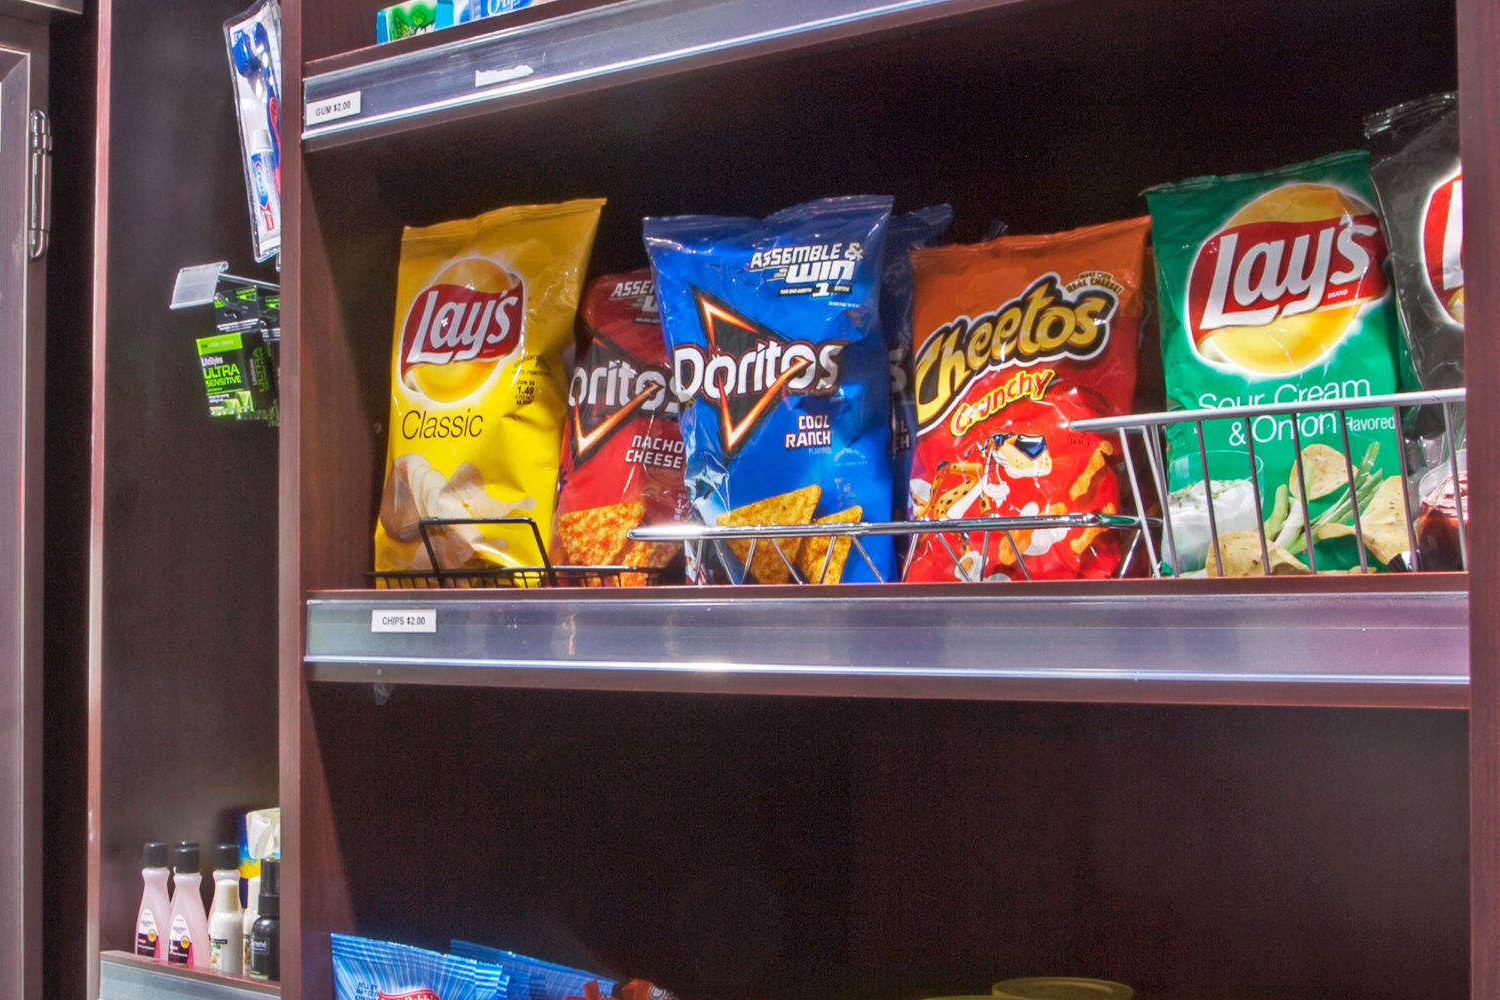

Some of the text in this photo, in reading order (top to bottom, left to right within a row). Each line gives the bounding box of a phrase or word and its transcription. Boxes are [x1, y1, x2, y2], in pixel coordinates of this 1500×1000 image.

[315, 101, 351, 117] GUM $2.00
[750, 242, 864, 270] ASSEMBLE &
[1200, 215, 1377, 331] Lay's
[1327, 288, 1349, 299] BRAND
[406, 289, 519, 365] Lay's
[916, 282, 1107, 424] Cheetos
[203, 363, 240, 380] ULTRA
[205, 375, 242, 388] SENSITIVE
[674, 340, 845, 403] Doritos
[1274, 379, 1371, 404] Cream
[952, 371, 1055, 435] Crunchy
[401, 408, 484, 440] Classic
[798, 414, 830, 430] COOL
[631, 435, 685, 454] NACHO
[785, 430, 832, 449] RANCH
[1229, 421, 1247, 447] &
[625, 449, 683, 469] CHEESE
[381, 616, 426, 626] CHIPS $2.00
